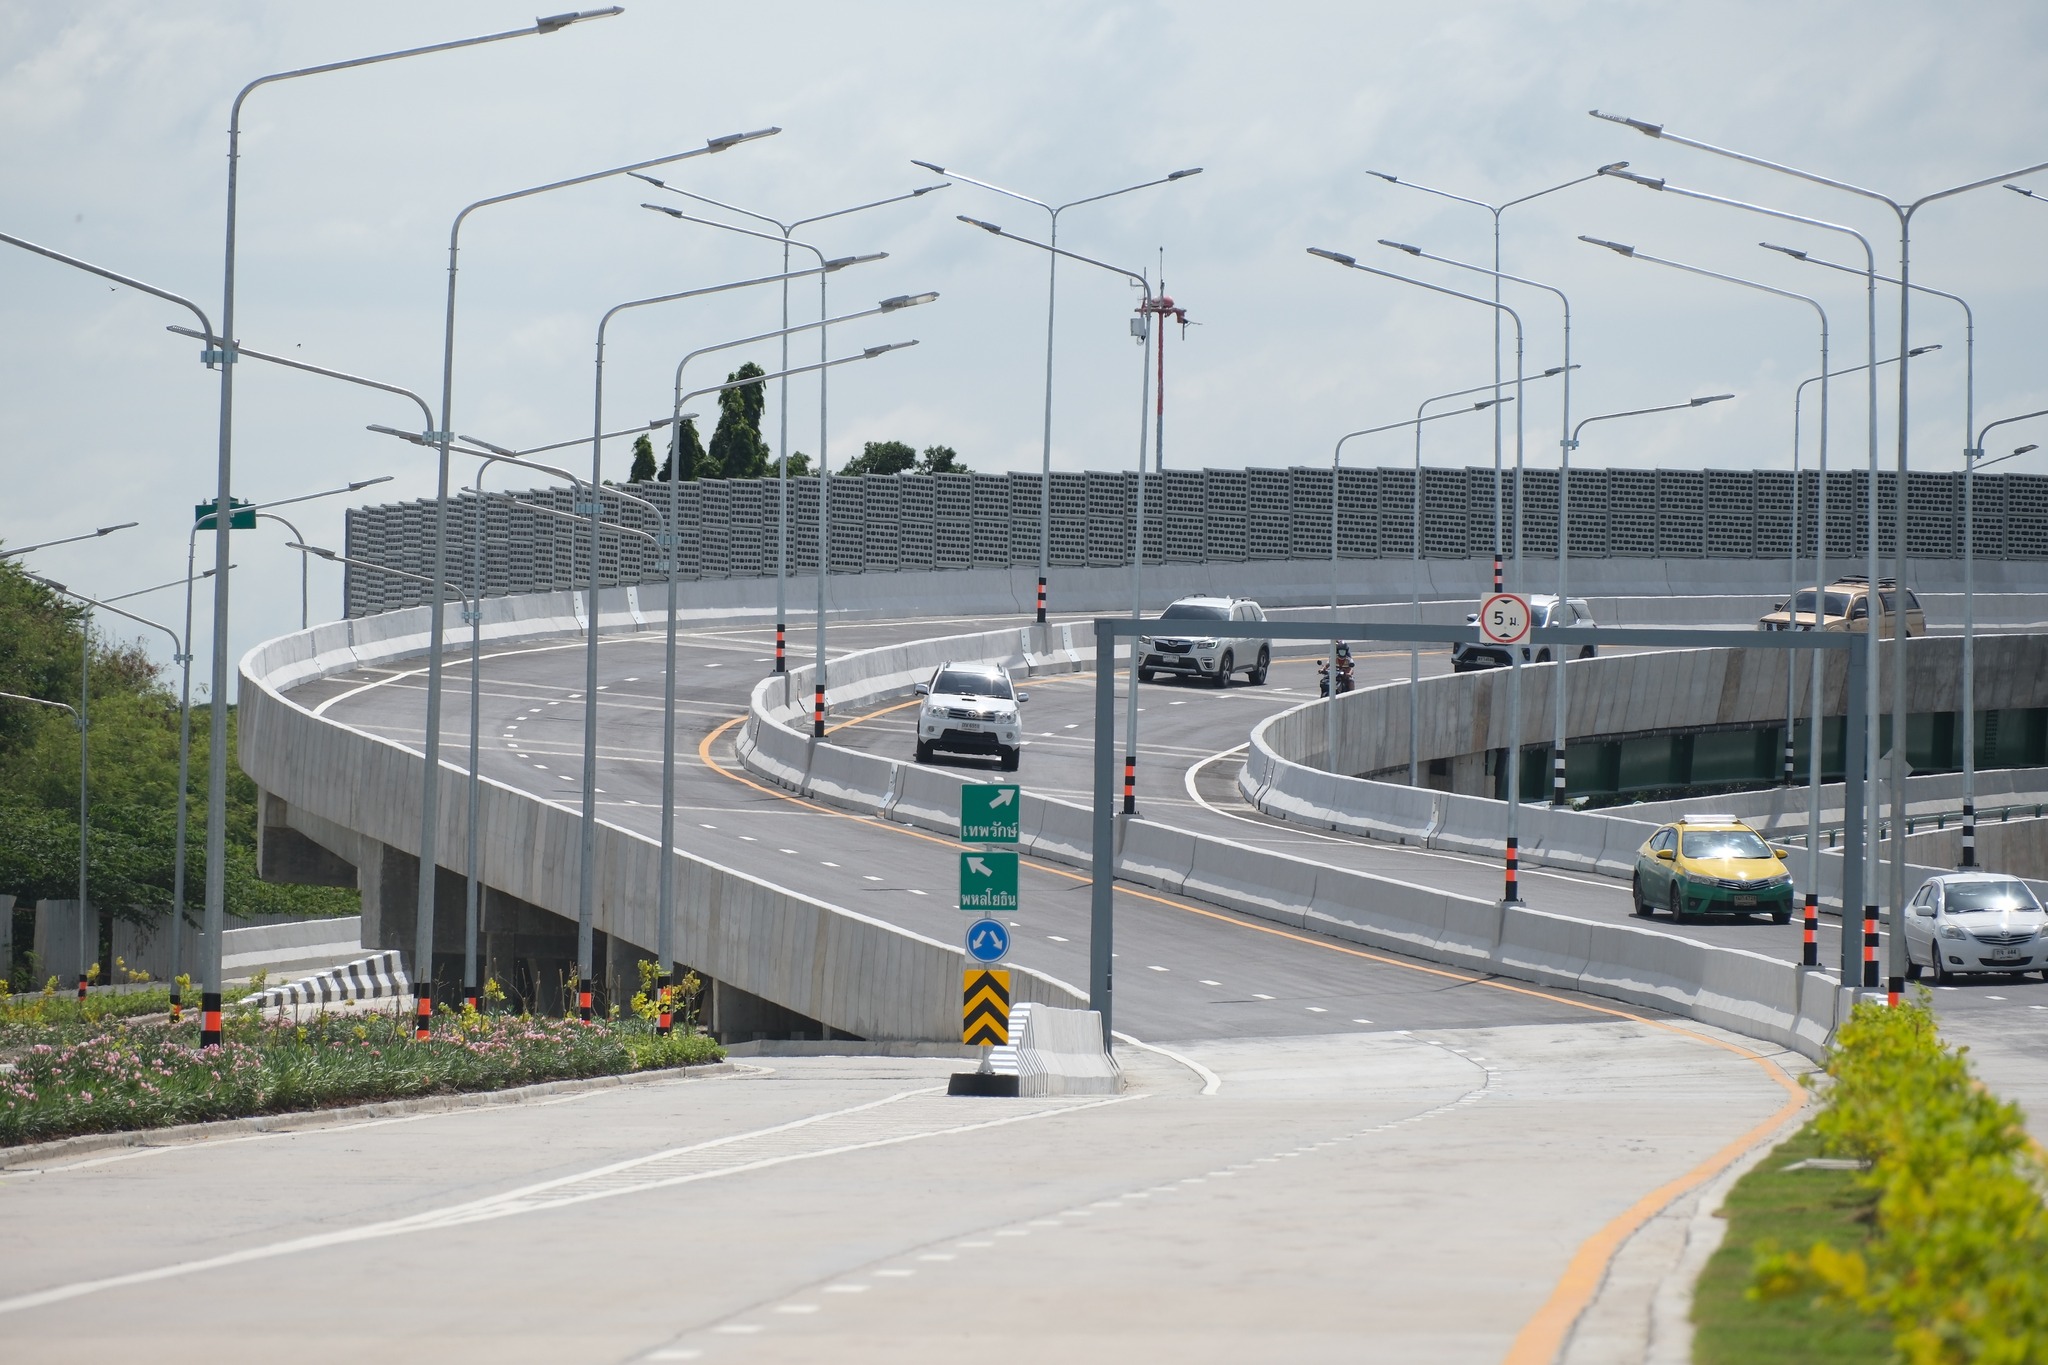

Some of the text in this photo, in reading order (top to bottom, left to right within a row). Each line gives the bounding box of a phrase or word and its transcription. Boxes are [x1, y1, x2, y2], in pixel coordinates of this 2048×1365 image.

[1494, 611, 1504, 625] 5
[963, 821, 1018, 838] เทพรักษ์
[961, 888, 1017, 907] พหลโยธิน
